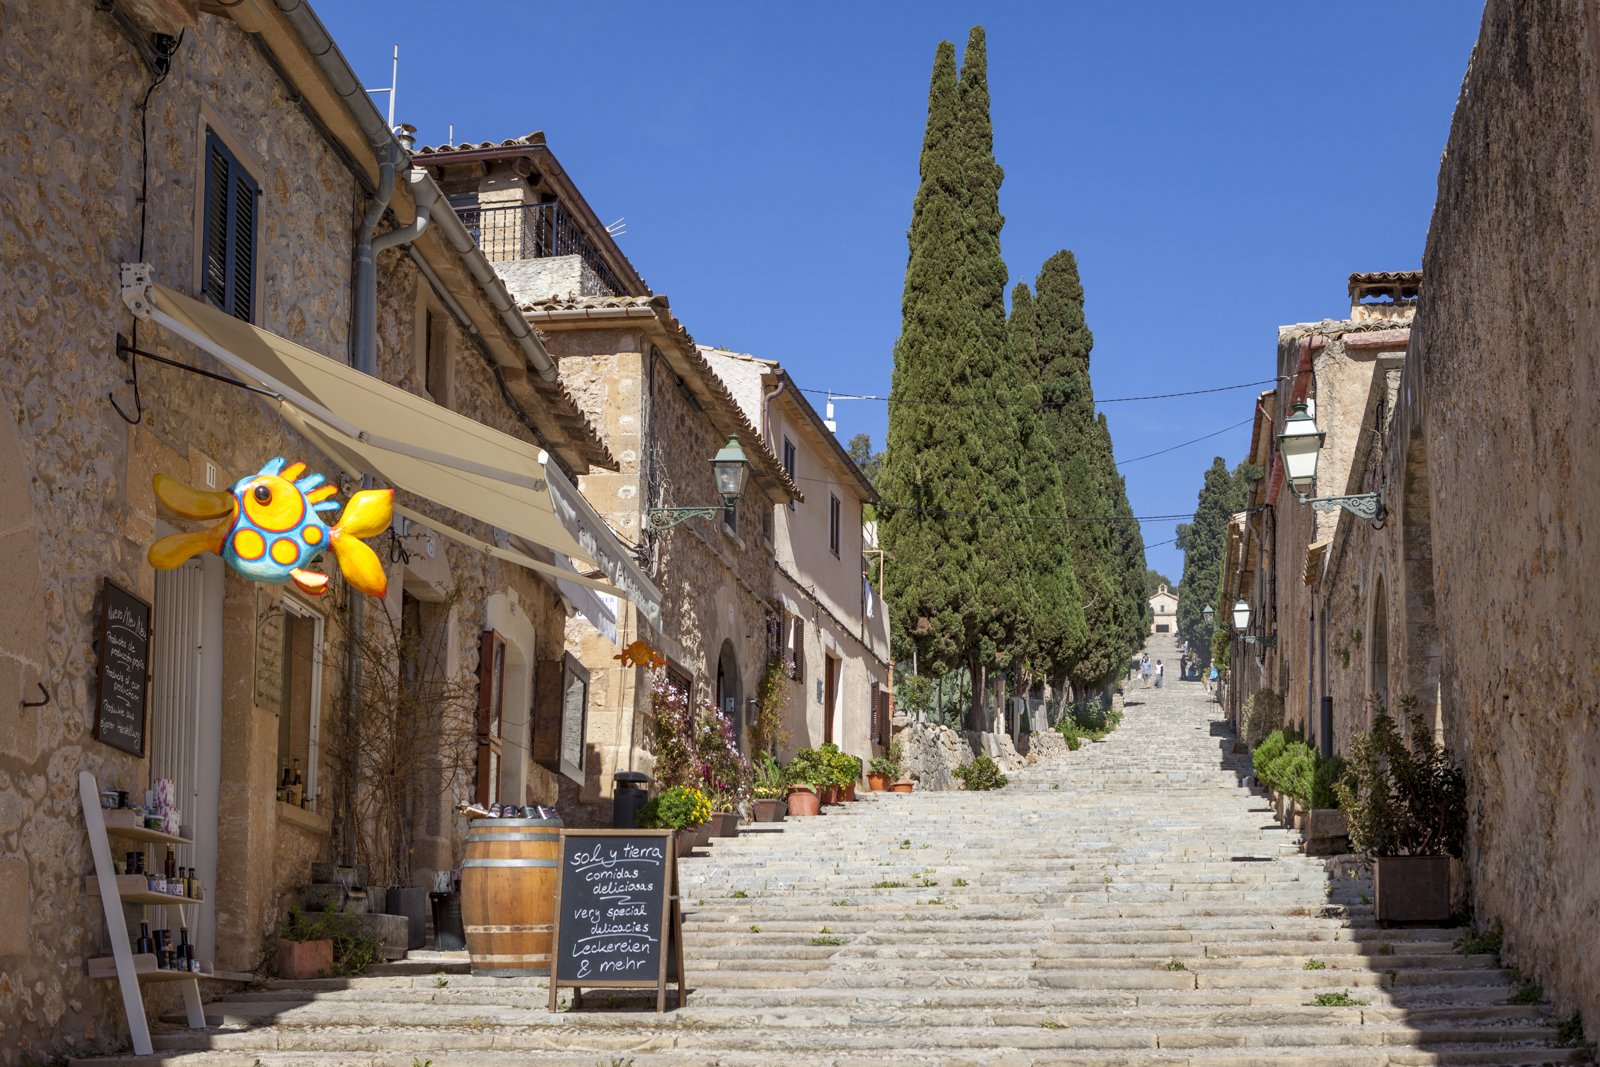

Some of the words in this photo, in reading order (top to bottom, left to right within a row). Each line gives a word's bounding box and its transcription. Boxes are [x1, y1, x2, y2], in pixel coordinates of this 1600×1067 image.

[128, 641, 136, 653] de
[601, 849, 618, 868] y
[623, 842, 663, 859] tierra
[585, 867, 639, 882] comidas
[573, 907, 601, 924] very
[606, 904, 648, 921] special
[590, 921, 650, 935] delicacies
[571, 940, 650, 958] Leckereien
[576, 959, 592, 979] &
[599, 956, 647, 973] mehr
